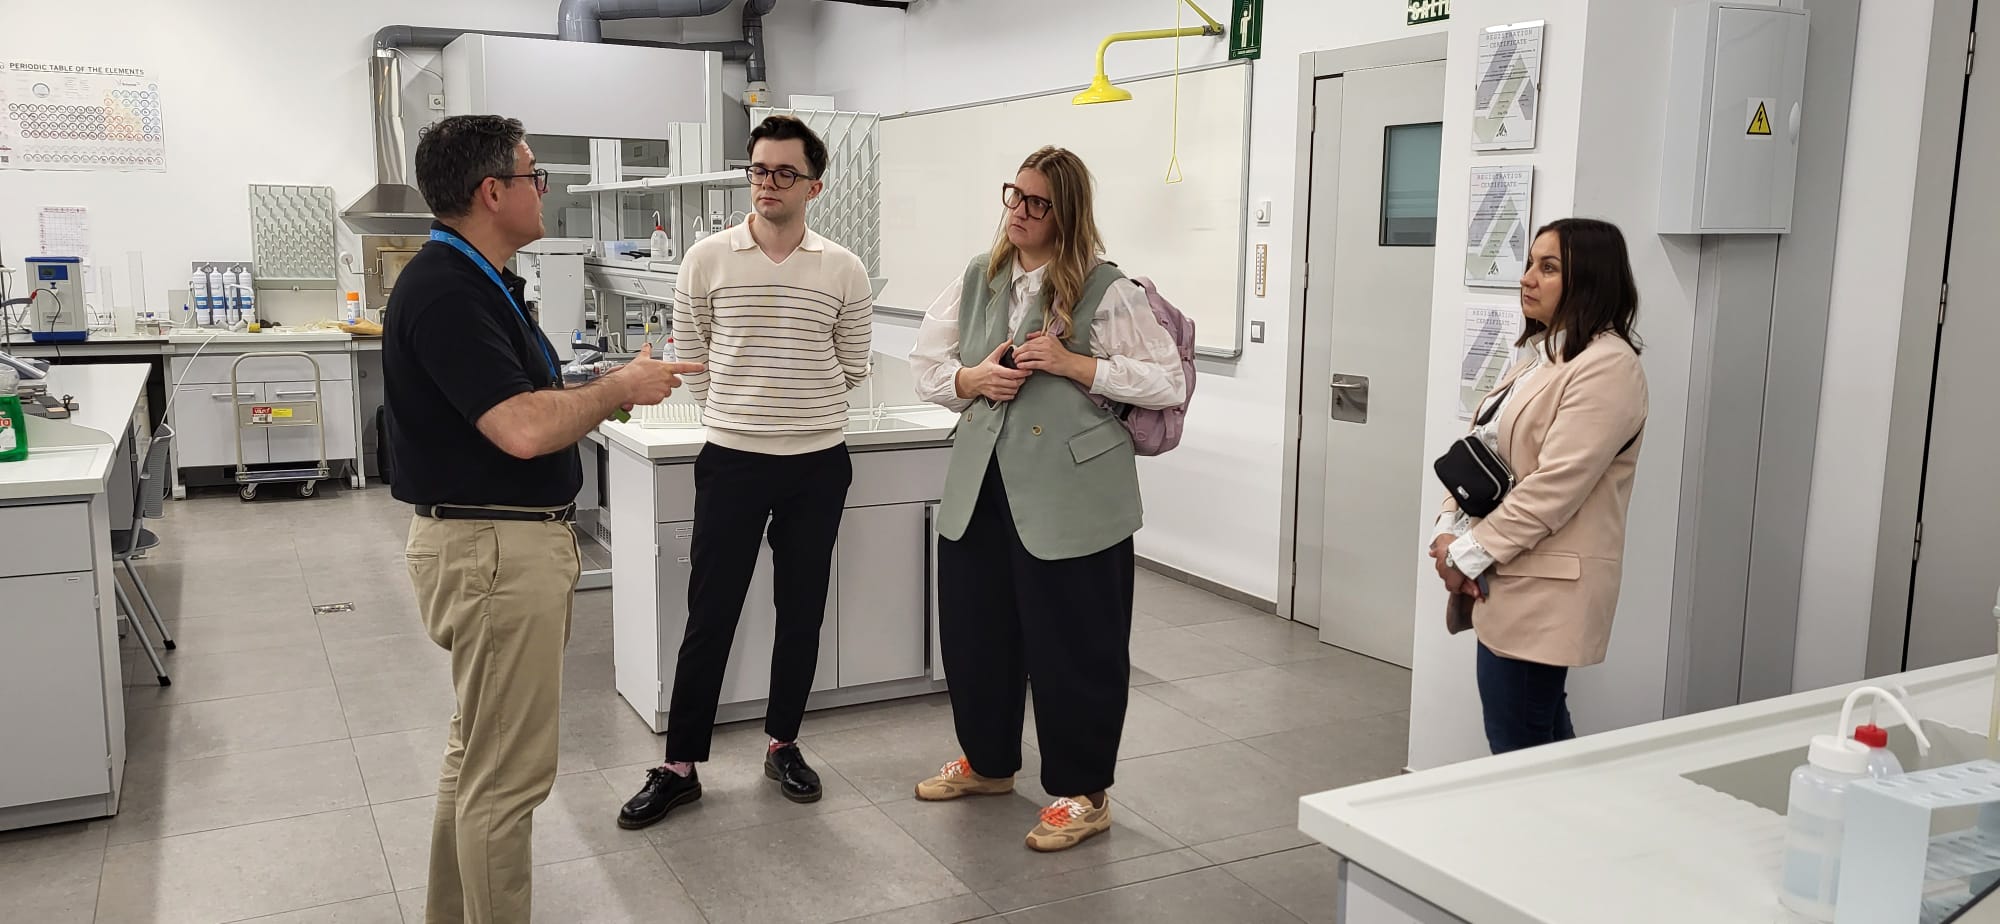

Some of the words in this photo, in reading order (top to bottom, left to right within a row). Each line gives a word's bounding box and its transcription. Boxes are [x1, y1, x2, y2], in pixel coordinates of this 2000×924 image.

[1486, 29, 1533, 40] REGISTRATION
[1489, 38, 1528, 48] CERTIFICATE
[9, 62, 47, 70] PERIODIC
[104, 67, 145, 75] ELEMENTS
